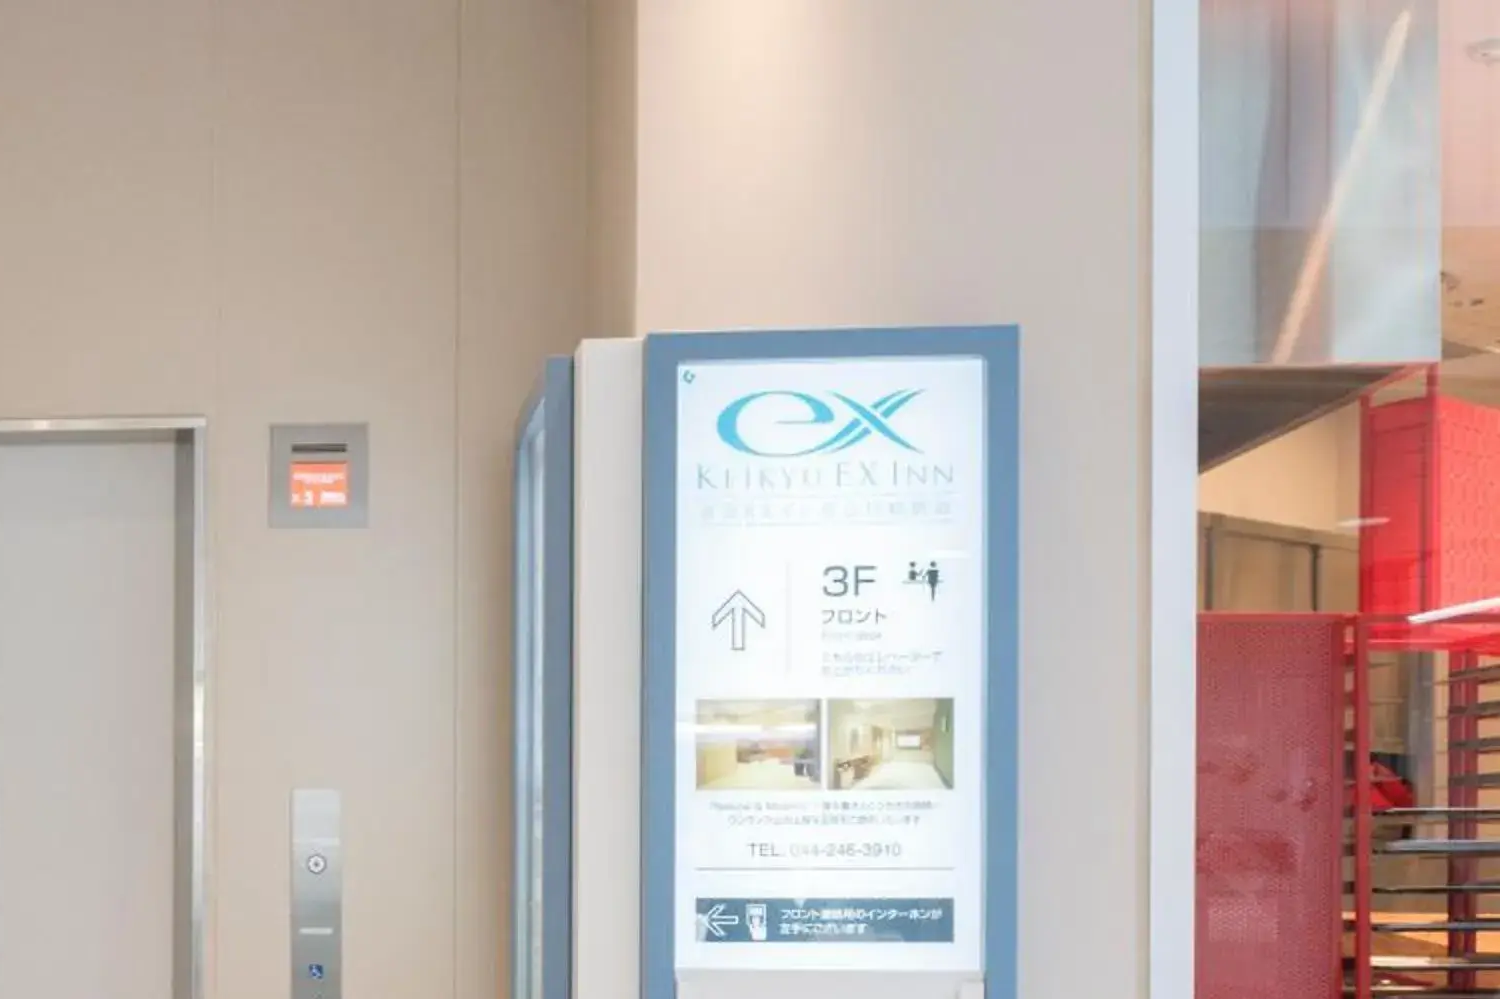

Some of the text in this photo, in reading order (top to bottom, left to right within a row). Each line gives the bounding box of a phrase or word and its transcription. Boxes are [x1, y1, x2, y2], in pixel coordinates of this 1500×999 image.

[835, 461, 878, 488] EX
[891, 460, 955, 488] INN
[822, 565, 877, 598] 3F
[821, 608, 888, 625] フロント
